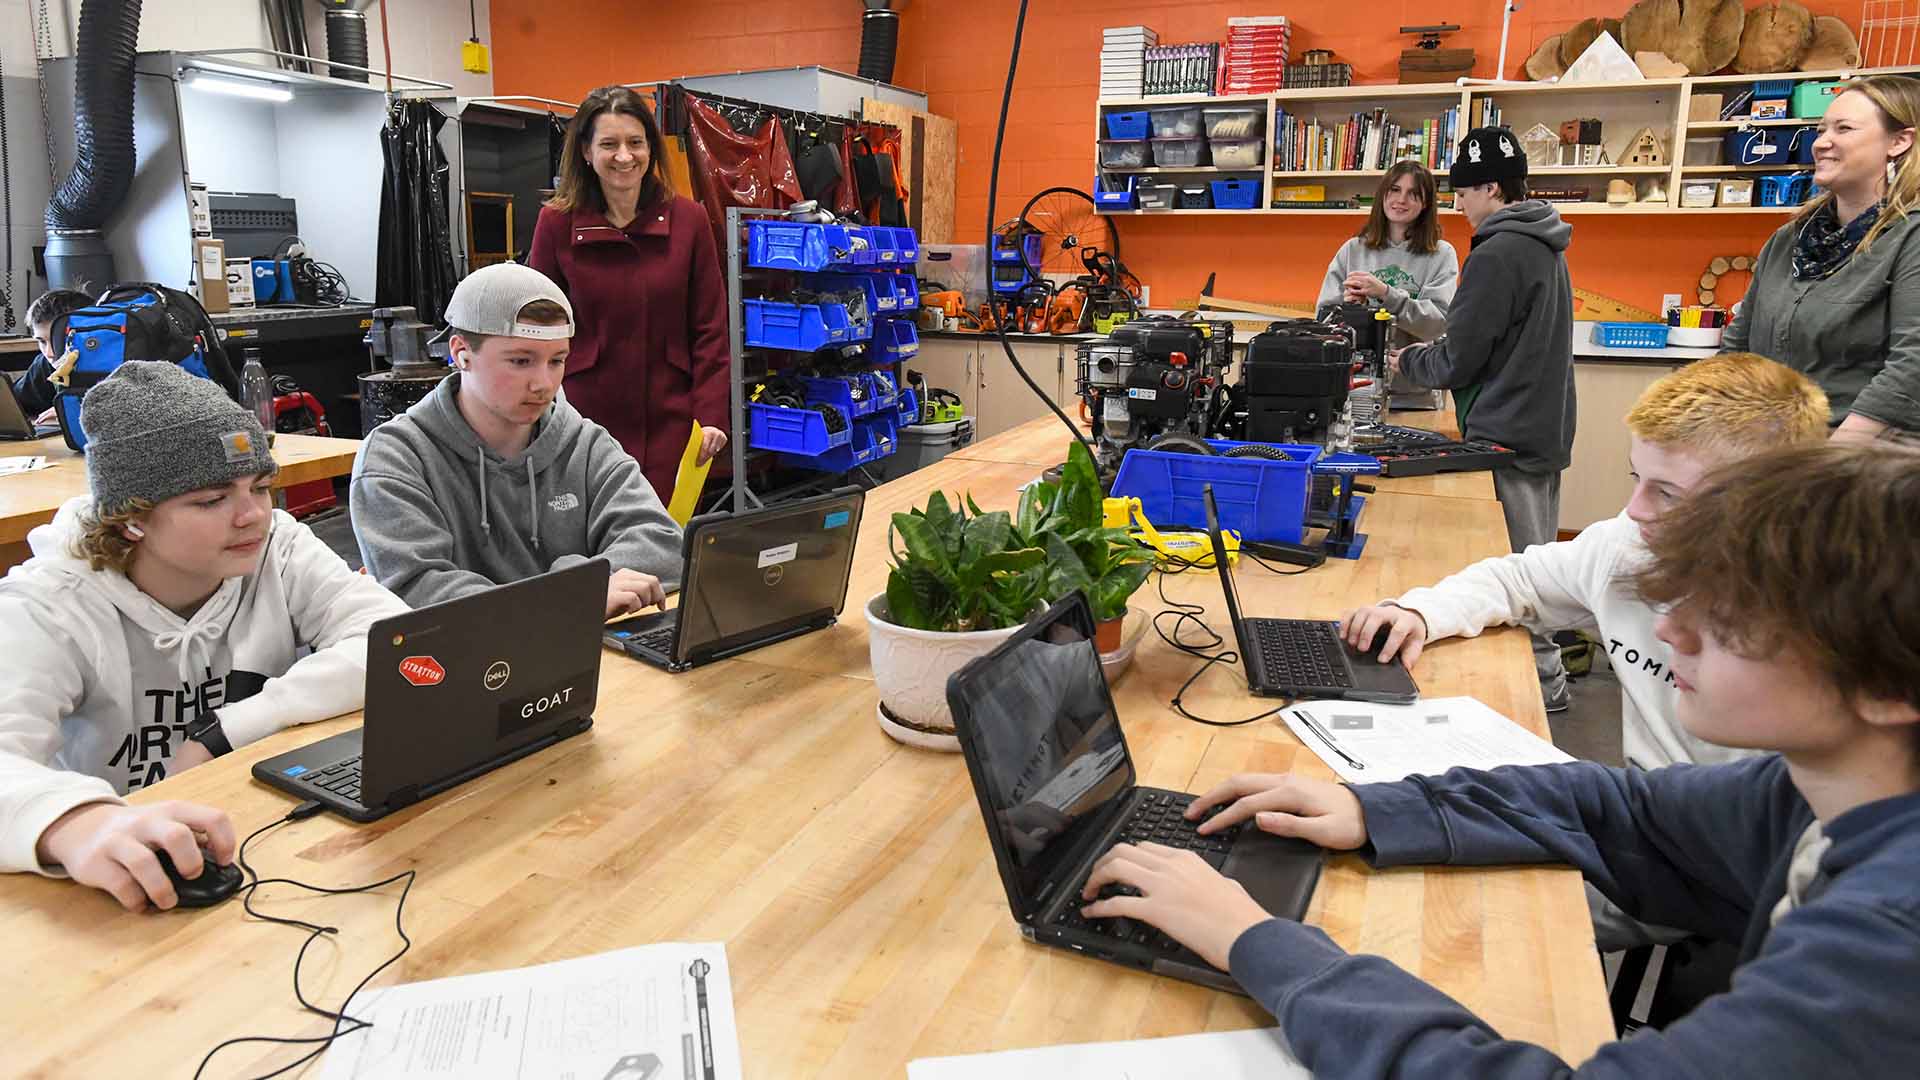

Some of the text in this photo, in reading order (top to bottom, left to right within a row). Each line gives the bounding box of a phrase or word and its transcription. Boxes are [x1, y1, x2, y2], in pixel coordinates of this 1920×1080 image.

[402, 660, 442, 681] STRATTON
[487, 670, 507, 682] DELL
[1610, 639, 1677, 688] TOMM
[145, 677, 222, 723] THE
[521, 687, 573, 719] GOAT
